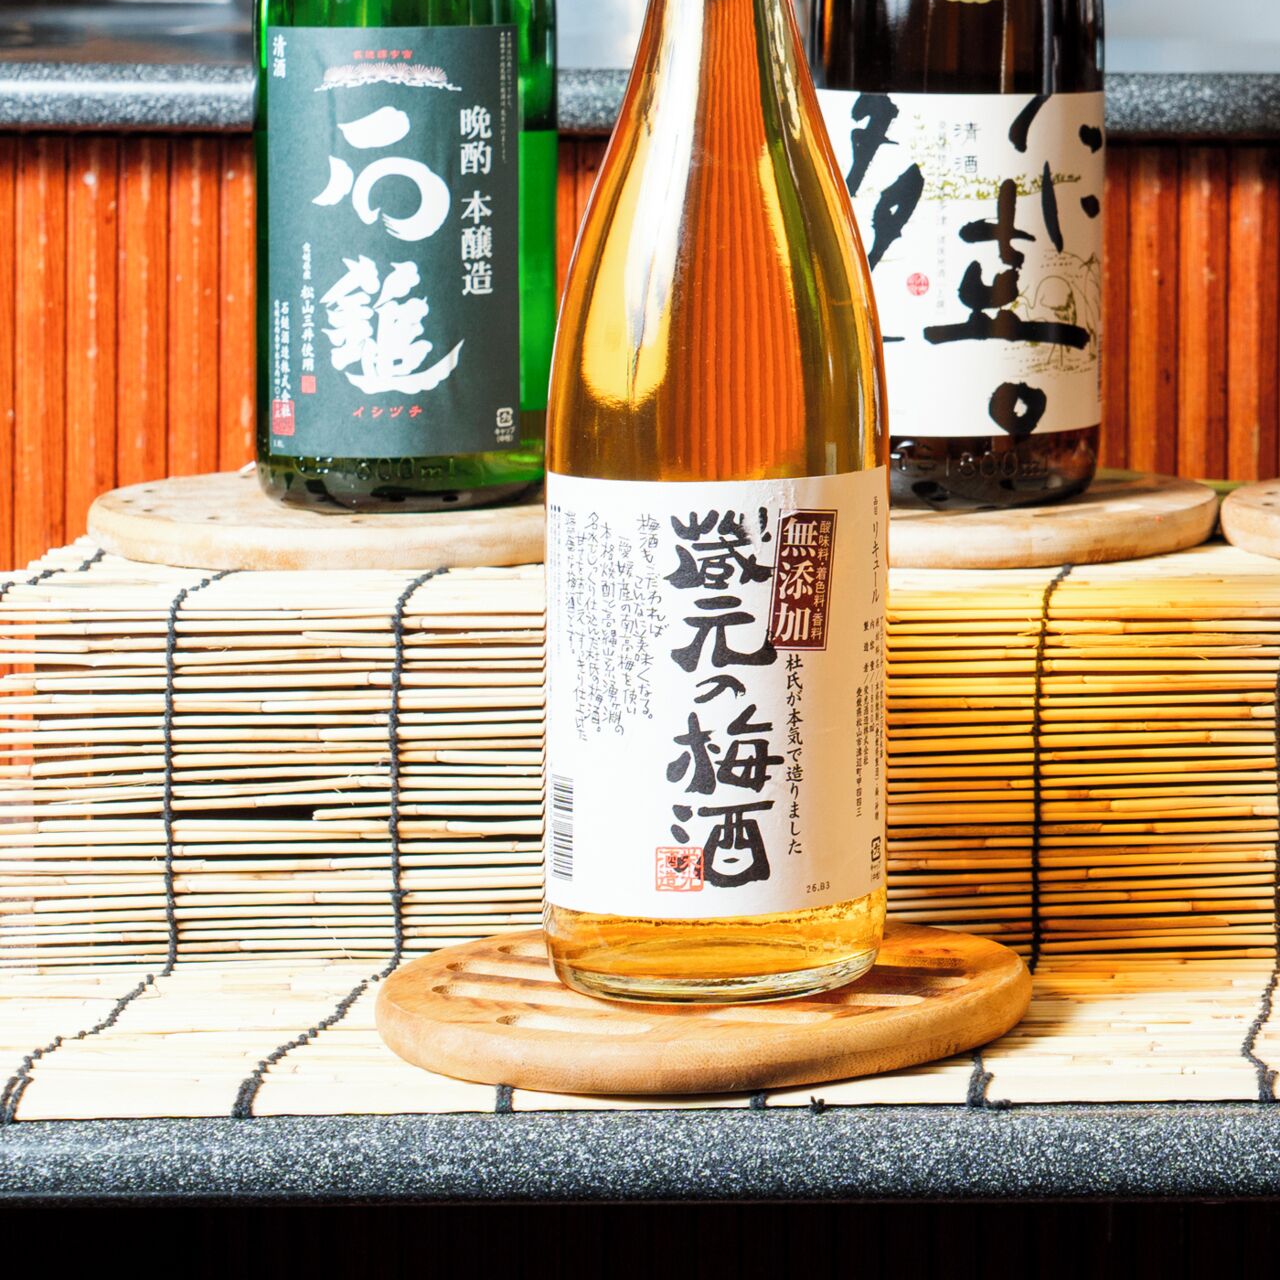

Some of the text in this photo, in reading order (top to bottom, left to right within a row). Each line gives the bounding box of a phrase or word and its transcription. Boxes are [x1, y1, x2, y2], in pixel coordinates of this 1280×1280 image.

[272, 34, 287, 79] 清酒
[459, 105, 494, 296] 晩酌 本醸造
[954, 122, 981, 174] 清酒
[311, 105, 465, 395] 石鎚
[637, 513, 670, 638] 梅酒もこだわれば
[774, 517, 818, 642] 無添加
[663, 505, 785, 888] 蔵元の梅酒
[785, 653, 804, 855] 杜氏が本気で造りました
